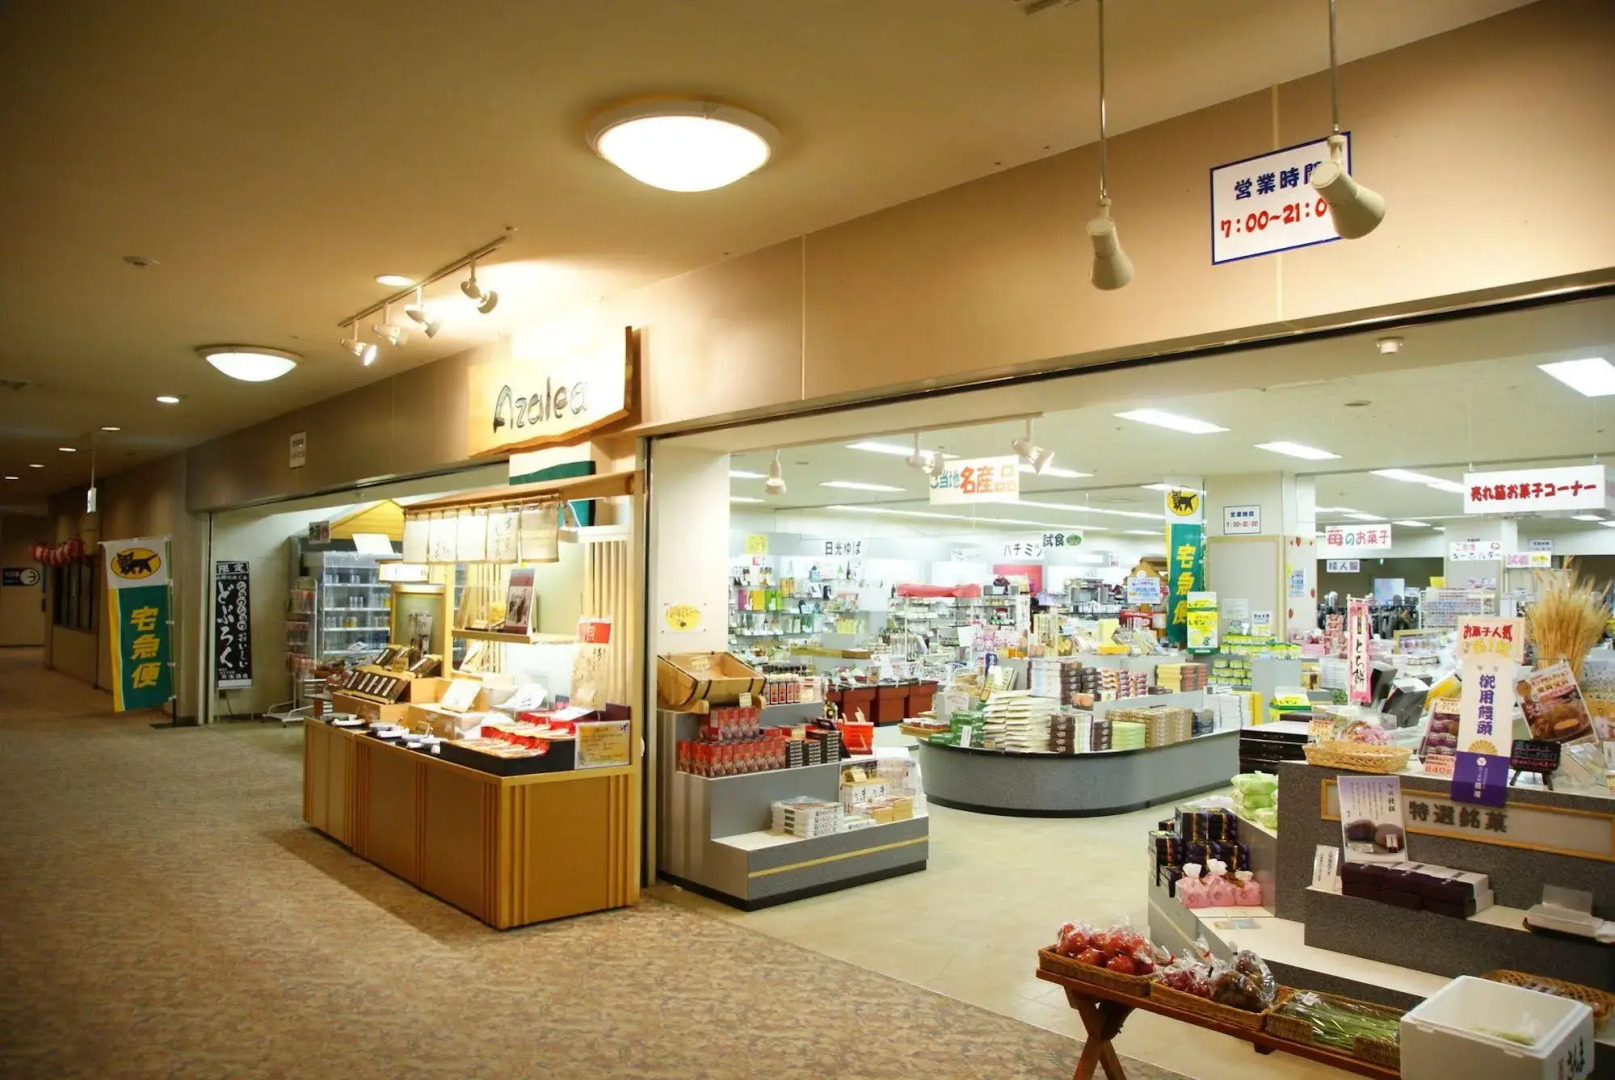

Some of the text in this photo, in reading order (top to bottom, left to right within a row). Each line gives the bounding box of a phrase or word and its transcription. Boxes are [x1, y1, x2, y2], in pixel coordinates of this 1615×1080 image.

[1221, 197, 1328, 238] 7:00~21:0
[493, 376, 590, 434] Azalea
[825, 541, 861, 556] 日光ゆば
[1003, 543, 1043, 557] ハチミツ
[1042, 533, 1065, 547] 試食
[1327, 529, 1389, 546] 苺のお菓子
[217, 581, 234, 668] どぶろく
[1463, 624, 1513, 641] お菓子人気
[130, 606, 162, 690] 宅急便
[1408, 800, 1509, 833] 特選銘菓
